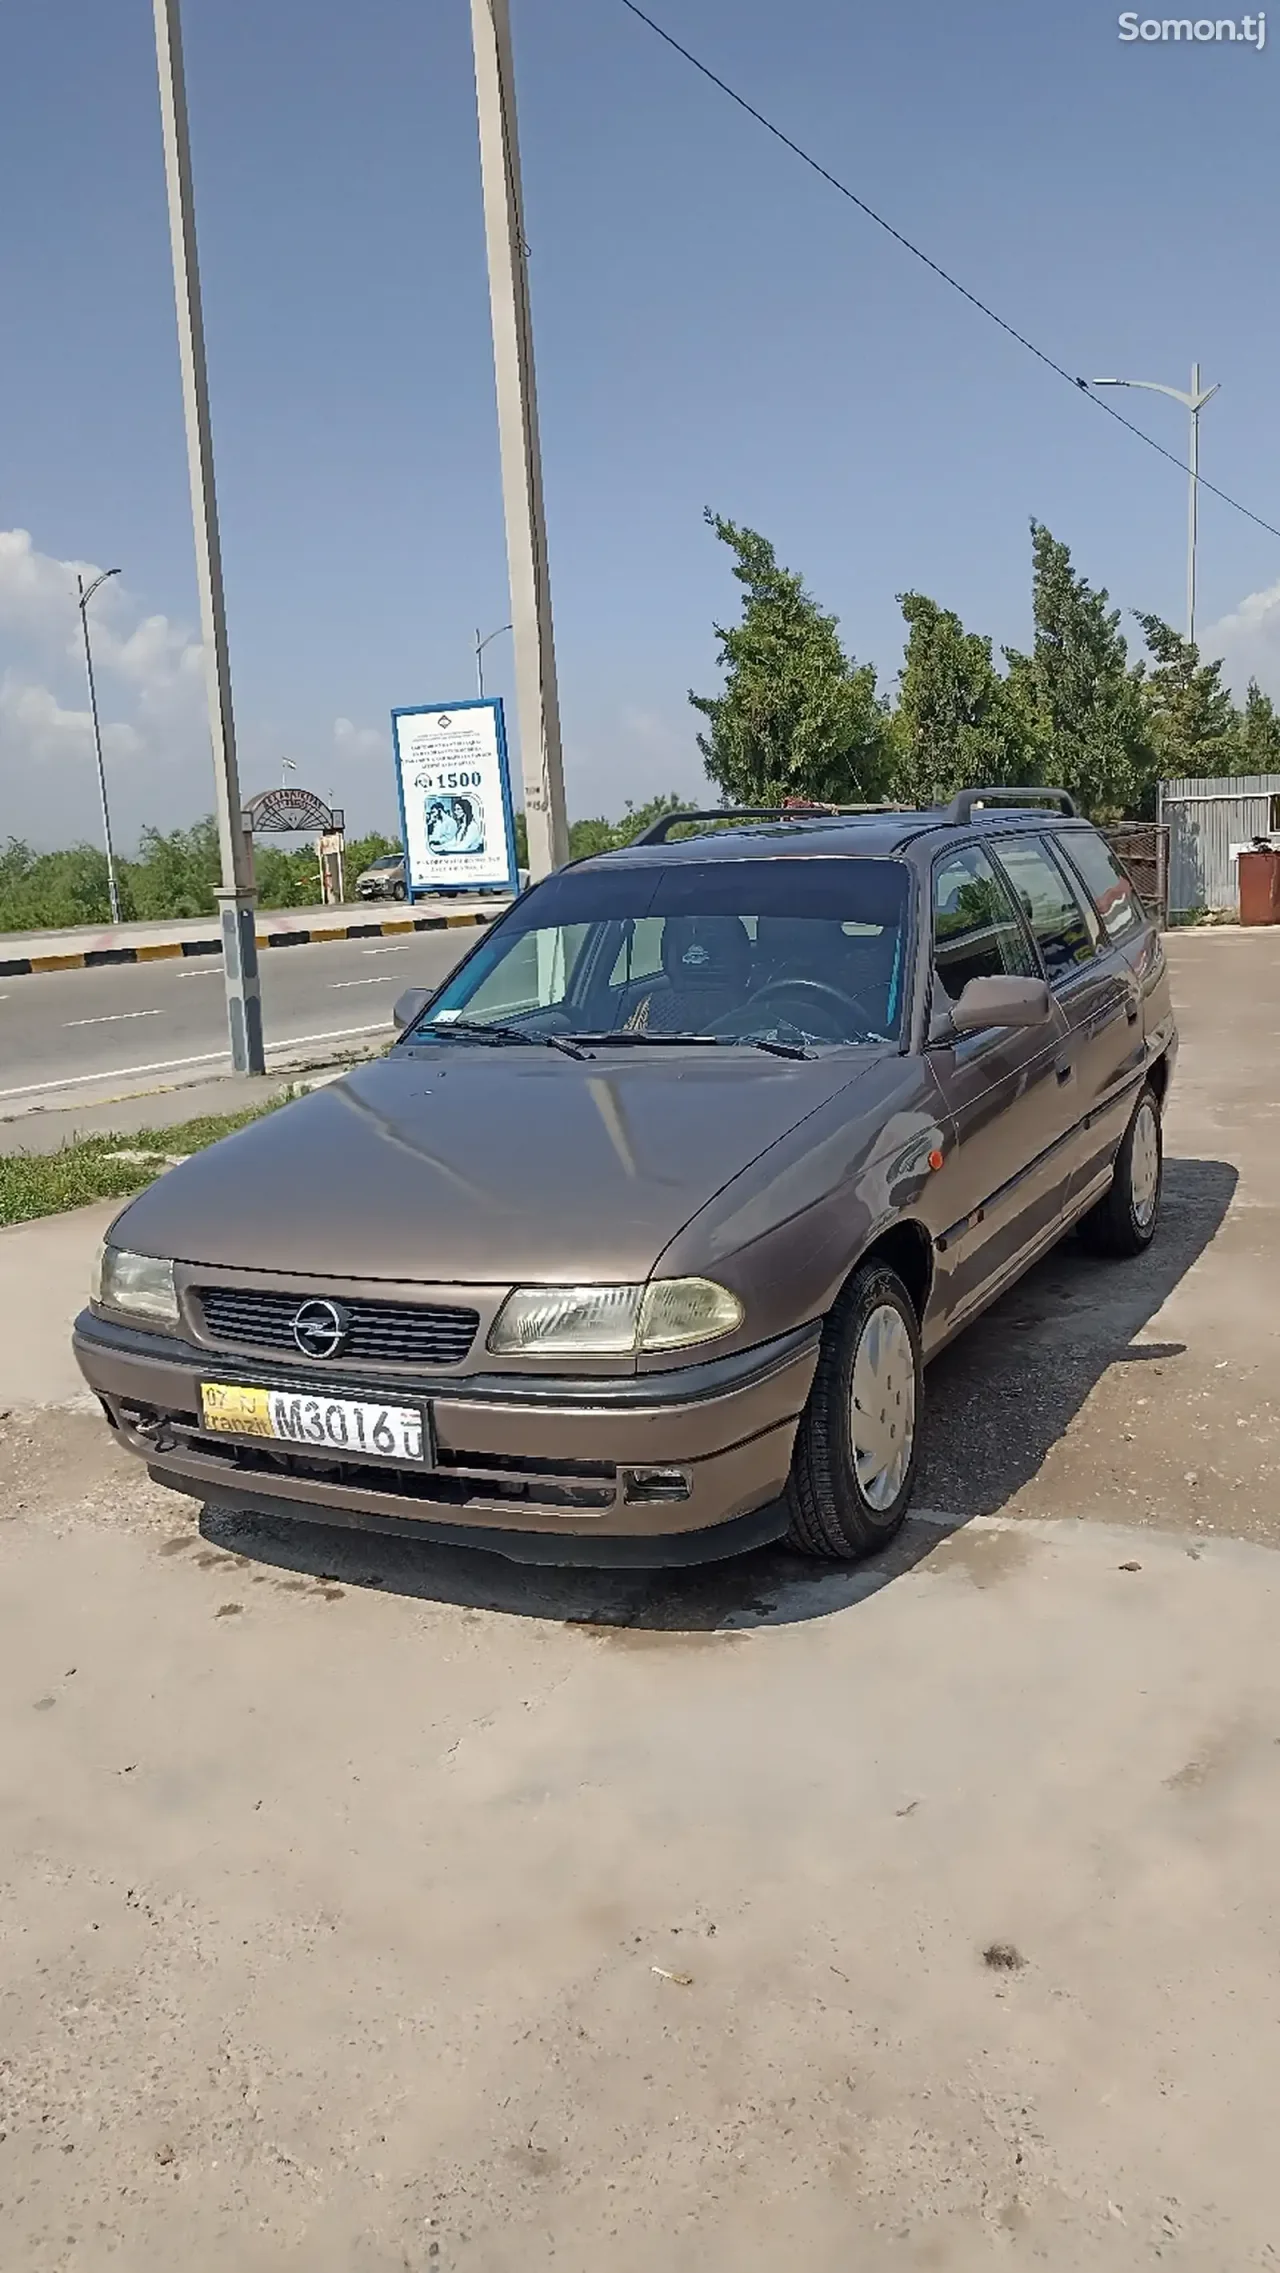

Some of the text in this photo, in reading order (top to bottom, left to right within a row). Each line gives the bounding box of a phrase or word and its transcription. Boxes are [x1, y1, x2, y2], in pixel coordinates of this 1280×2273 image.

[436, 771, 482, 789] 1500
[206, 1387, 227, 1406] 07
[274, 1397, 396, 1454] M3016
